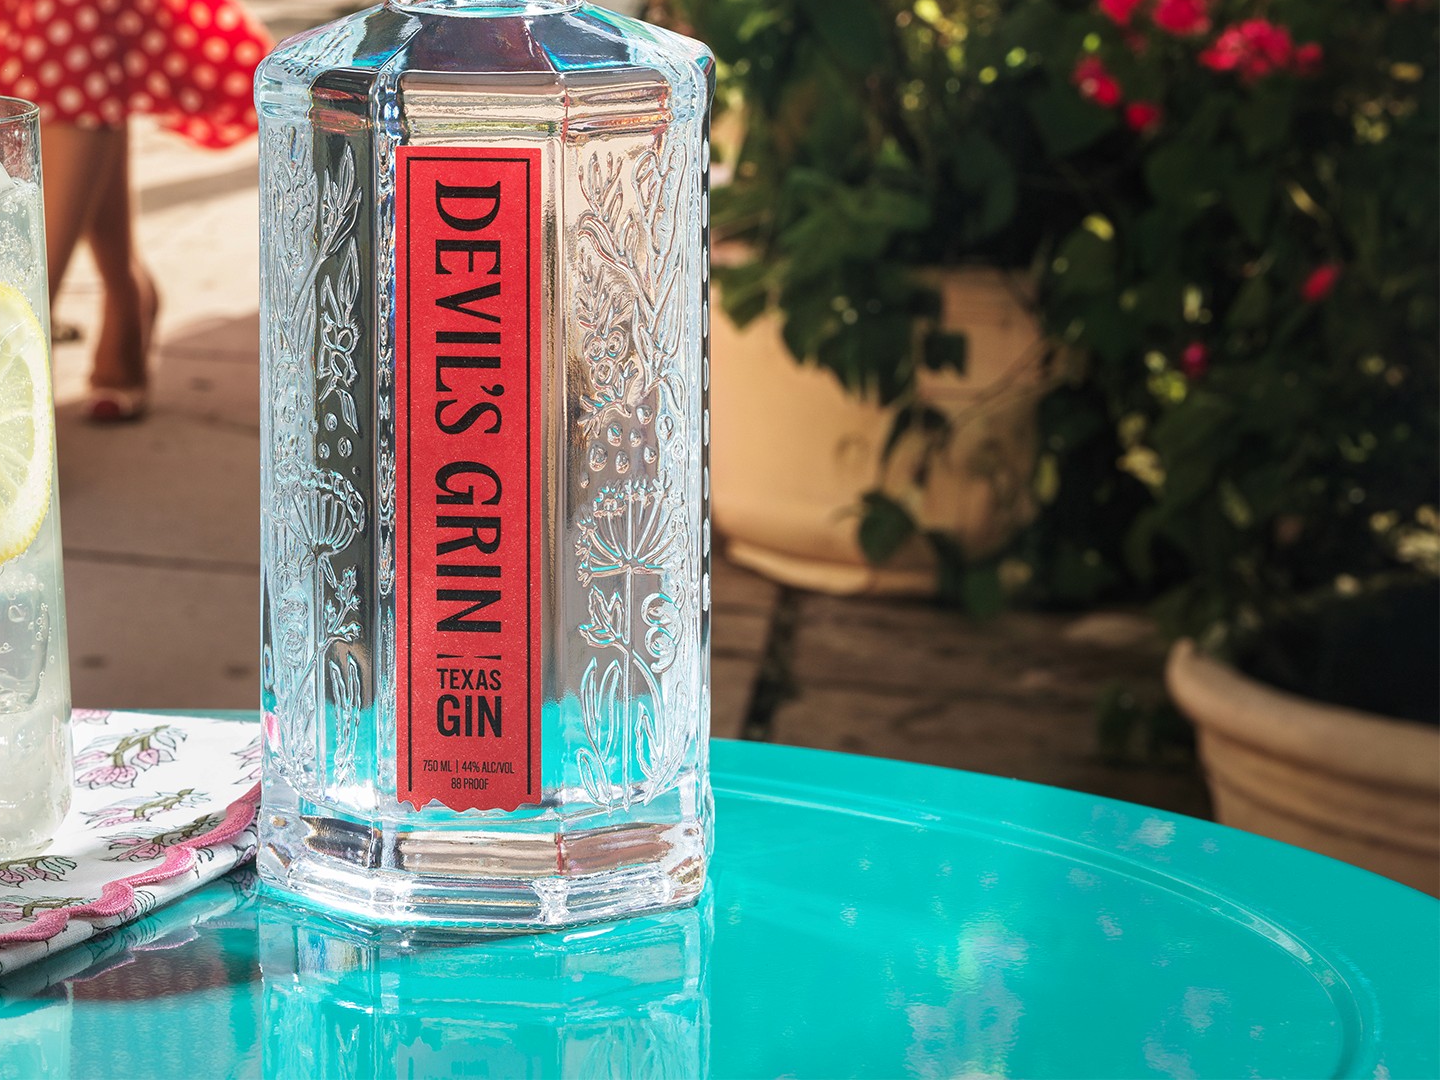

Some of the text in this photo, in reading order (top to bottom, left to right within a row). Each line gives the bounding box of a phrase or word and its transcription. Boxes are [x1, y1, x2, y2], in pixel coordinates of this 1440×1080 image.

[434, 179, 504, 634] DEVIL'S GRIN
[436, 667, 502, 691] TEXAS
[436, 693, 502, 738] GIN
[422, 759, 439, 772] 750
[440, 760, 453, 773] ML
[461, 761, 481, 773] 44%
[481, 761, 515, 775] ALC/VOL
[450, 777, 489, 791] 88 PROOF
